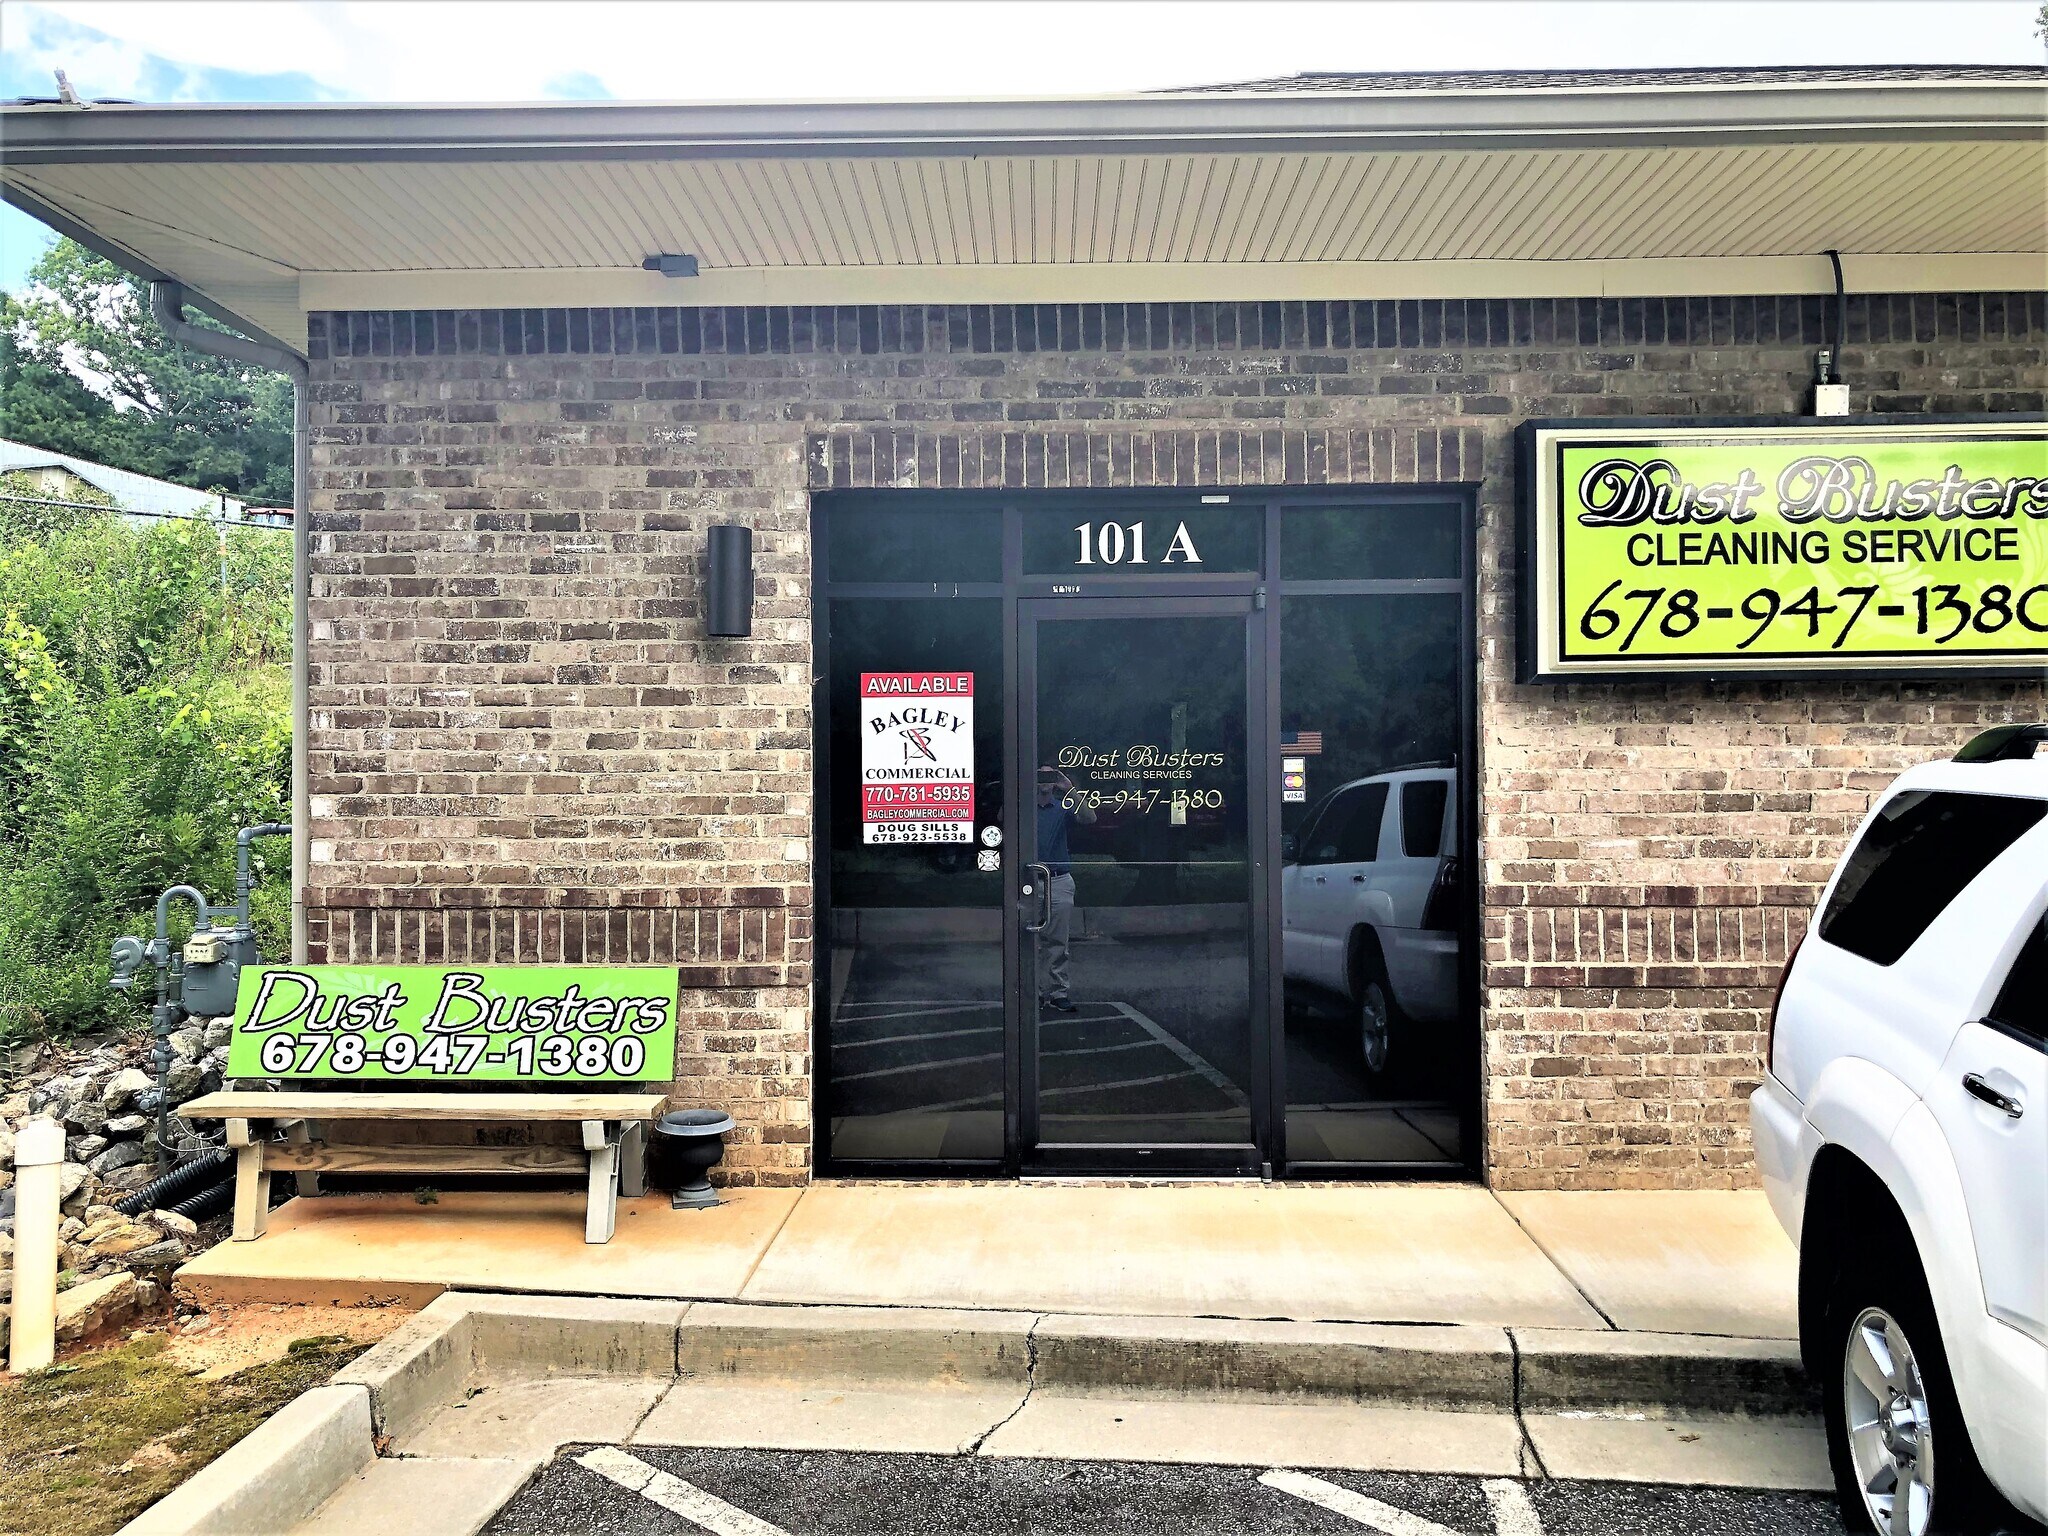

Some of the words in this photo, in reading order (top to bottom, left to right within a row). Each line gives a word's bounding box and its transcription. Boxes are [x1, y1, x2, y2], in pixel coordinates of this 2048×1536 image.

[1578, 458, 1765, 528] Dust
[1776, 455, 2048, 524] Busters
[1074, 521, 1149, 565] 101
[1160, 520, 1203, 563] A
[1627, 530, 1831, 567] CLEANING
[1842, 527, 2020, 563] SERVICE
[866, 677, 969, 693] AVAILABLE
[869, 707, 966, 735] BAGLEY
[1058, 745, 1120, 768] Dust
[1126, 744, 1224, 768] Busters
[865, 767, 970, 779] COMMERCIAL
[1090, 770, 1140, 780] CLEANING
[1143, 770, 1192, 780] SERVICES
[865, 786, 970, 802] 770-781-5935
[1061, 786, 1223, 814] 678-947-1380
[867, 808, 969, 819] BAGLEYCOMMERCIAL.COM
[872, 833, 967, 842] 678-923-5538
[877, 823, 916, 832] DOUG
[921, 823, 959, 831] SILLS
[241, 970, 408, 1033] Dust
[424, 972, 671, 1033] Busters
[260, 1032, 646, 1075] 678-947-1380
